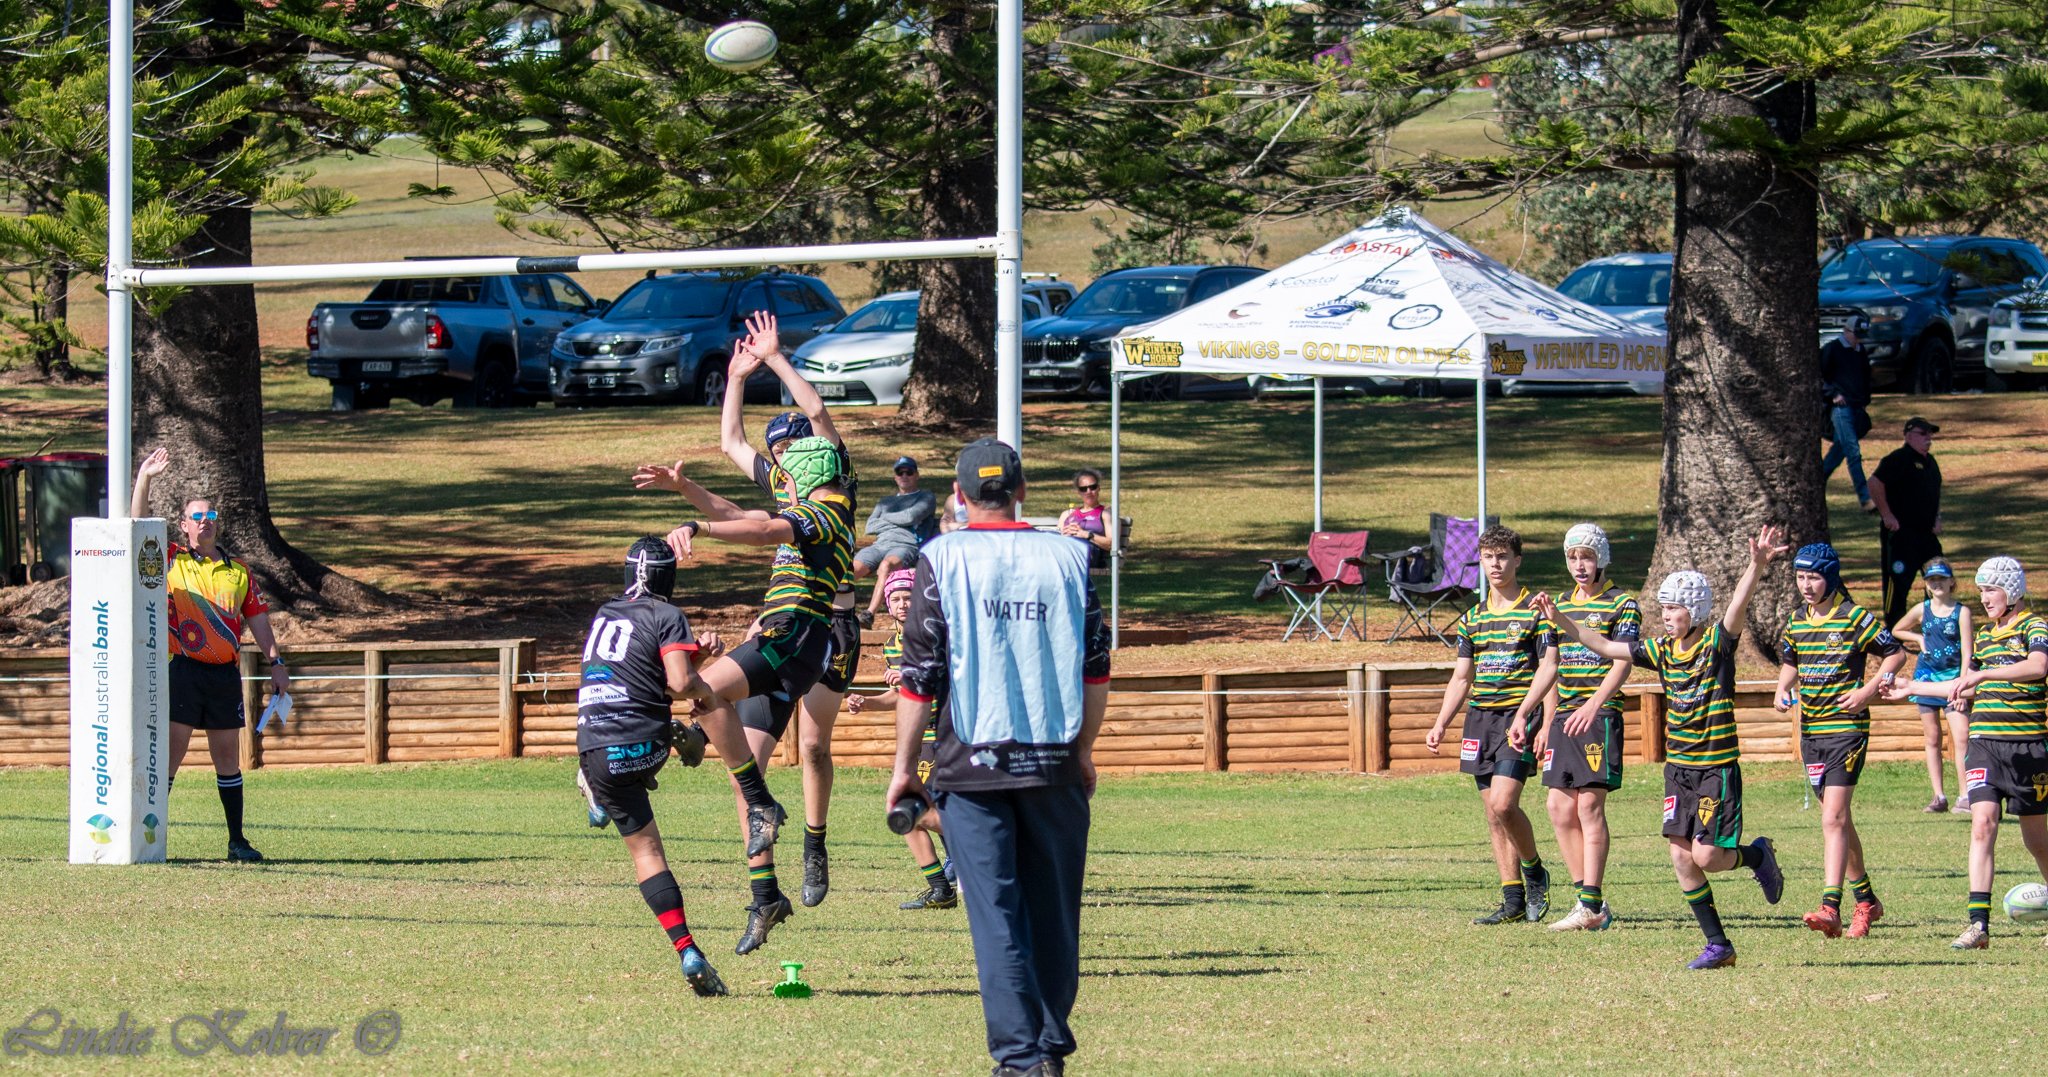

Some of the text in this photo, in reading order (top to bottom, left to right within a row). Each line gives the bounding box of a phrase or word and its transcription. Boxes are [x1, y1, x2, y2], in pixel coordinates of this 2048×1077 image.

[1150, 354, 1178, 363] HORNS
[1198, 341, 1280, 360] VIKINGS
[1302, 341, 1389, 363] GOLDEN
[1395, 346, 1472, 365] OLDIES
[1533, 343, 1620, 370] WRINKLED
[1622, 344, 1667, 371] HORN
[983, 599, 1048, 622] WATER
[583, 617, 634, 662] 10
[1008, 750, 1025, 761] Big
[2021, 889, 2048, 901] GILB
